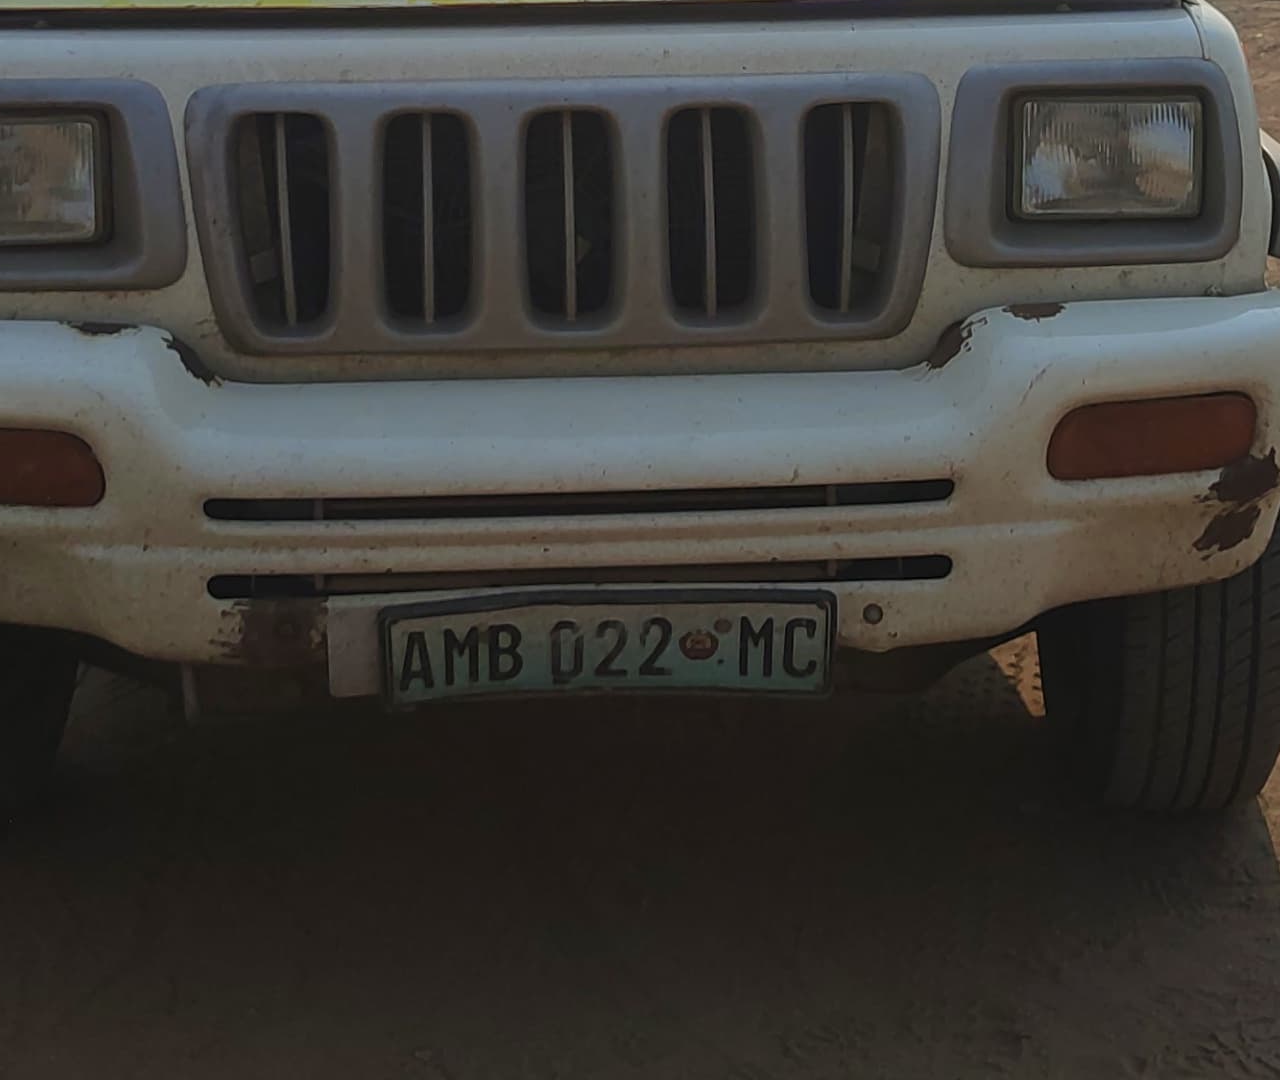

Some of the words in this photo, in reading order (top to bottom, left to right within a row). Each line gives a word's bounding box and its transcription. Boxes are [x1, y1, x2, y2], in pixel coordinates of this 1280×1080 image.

[399, 623, 523, 692] AMB
[549, 617, 674, 685] 022
[738, 615, 818, 680] MC
